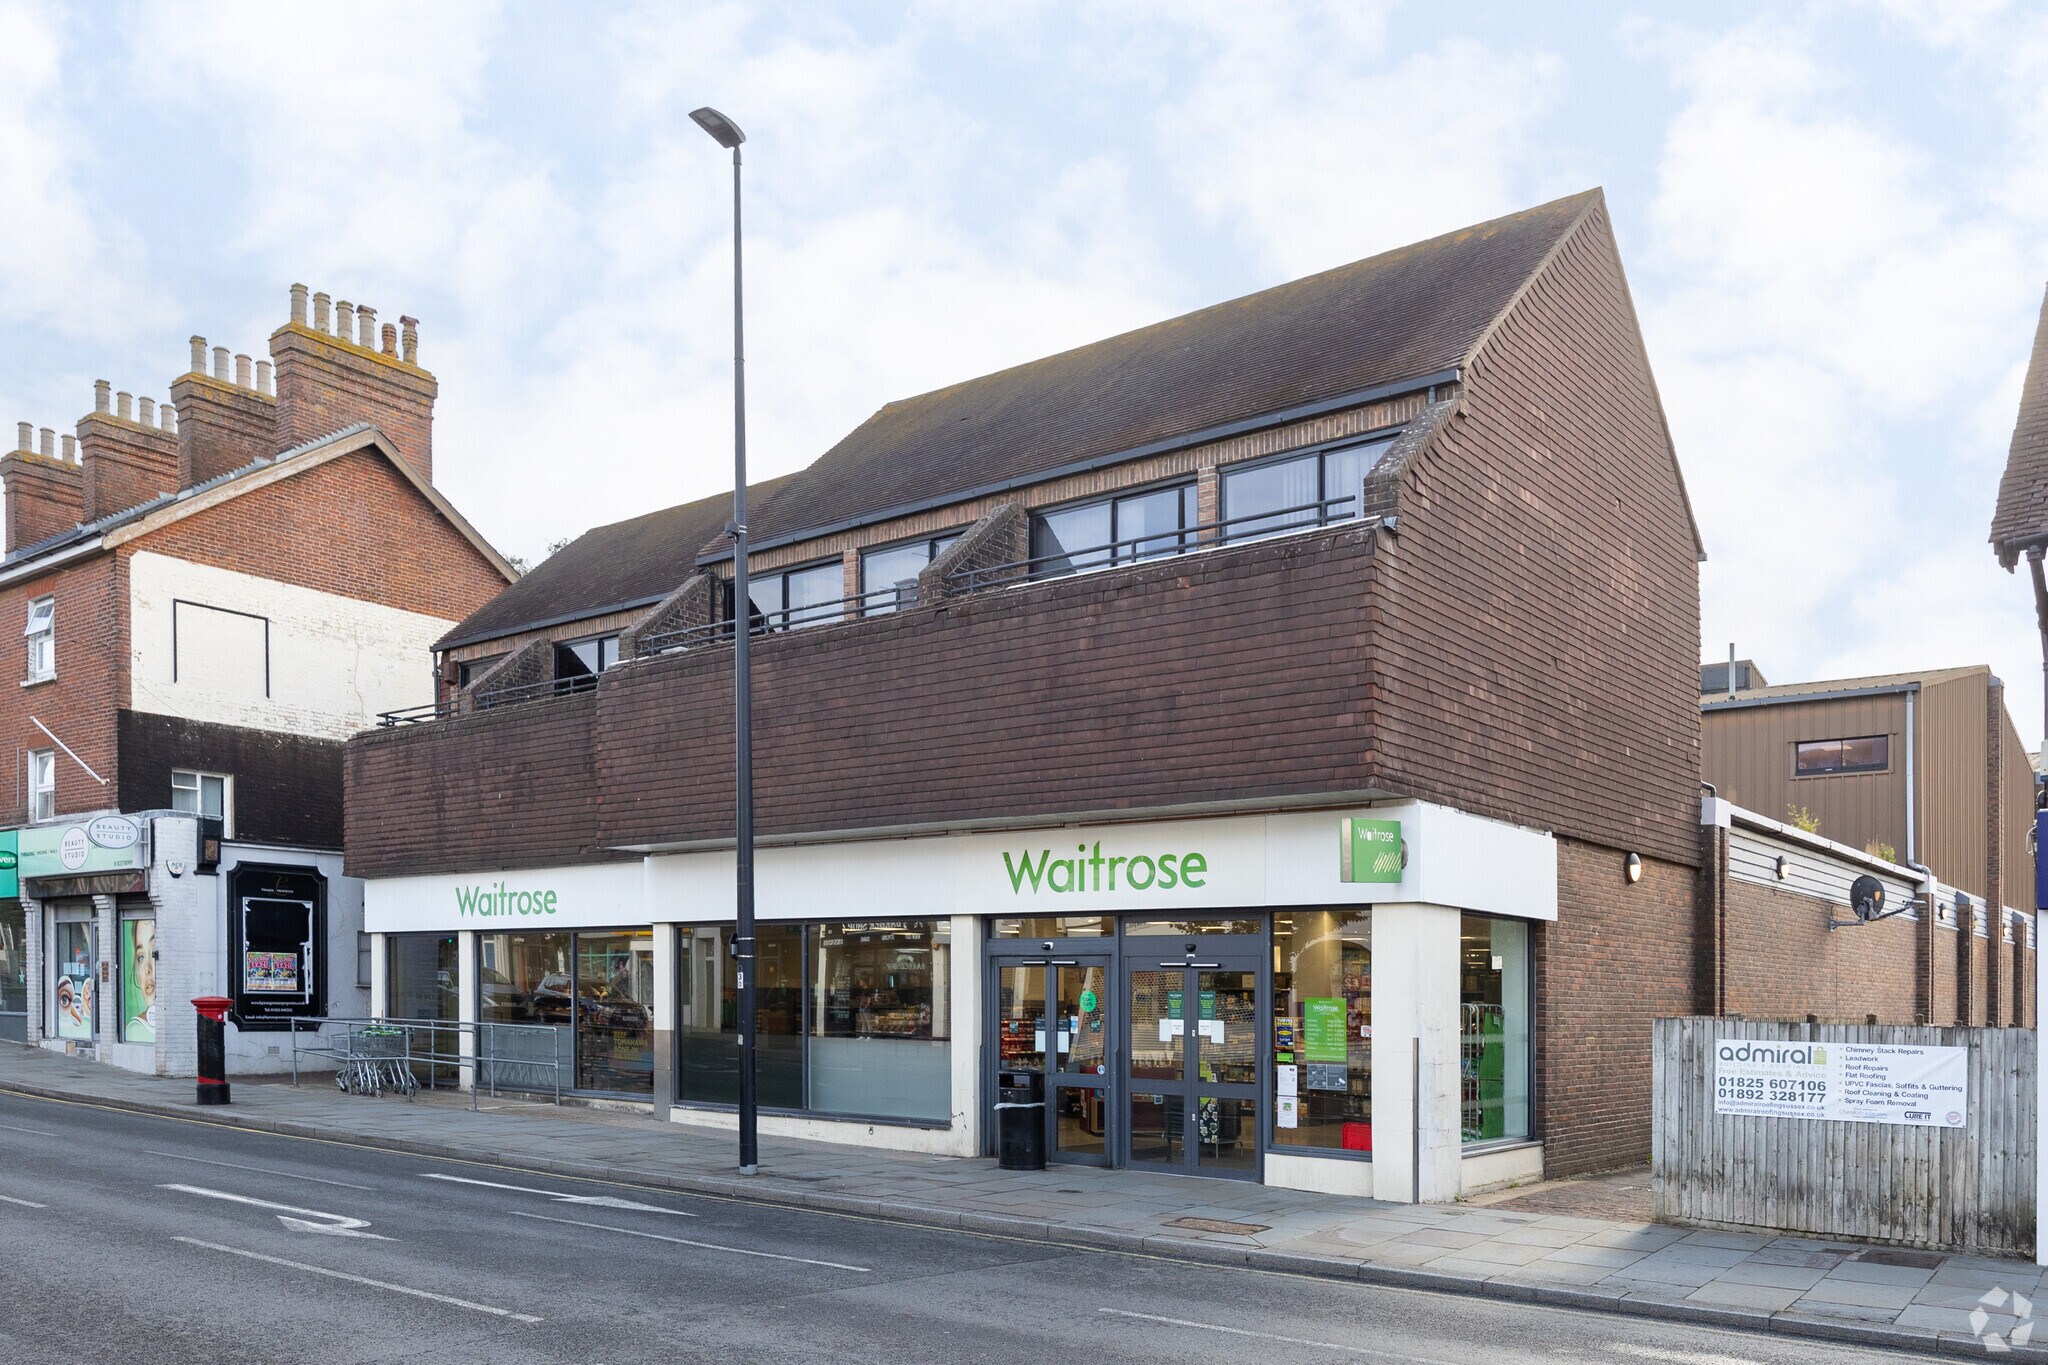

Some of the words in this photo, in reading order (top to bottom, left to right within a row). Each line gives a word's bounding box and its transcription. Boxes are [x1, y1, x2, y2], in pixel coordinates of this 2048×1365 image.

[96, 833, 132, 841] STUDIO
[1357, 827, 1394, 842] Waitrose
[64, 839, 84, 847] BEAUTY
[64, 851, 84, 859] STUDIO
[1002, 840, 1208, 895] Waitrose
[455, 880, 557, 917] Waitrose
[1312, 1004, 1339, 1012] Waitrose
[1720, 1043, 1811, 1064] admiral
[1740, 1069, 1782, 1077] Estimates
[1719, 1076, 1764, 1088] 01825
[1769, 1079, 1827, 1091] 607106
[1929, 1084, 1963, 1092] Guttering
[1719, 1088, 1764, 1100] 01892
[1769, 1090, 1826, 1102] 328177
[1863, 1090, 1891, 1098] Cleaning
[1902, 1092, 1928, 1100] Coating
[1718, 1100, 1825, 1110] info@admiralroofingsussex.co.uk
[1718, 1107, 1825, 1118] www.admiralroofingsussex.co.uk
[1904, 1111, 1923, 1119] CURE
